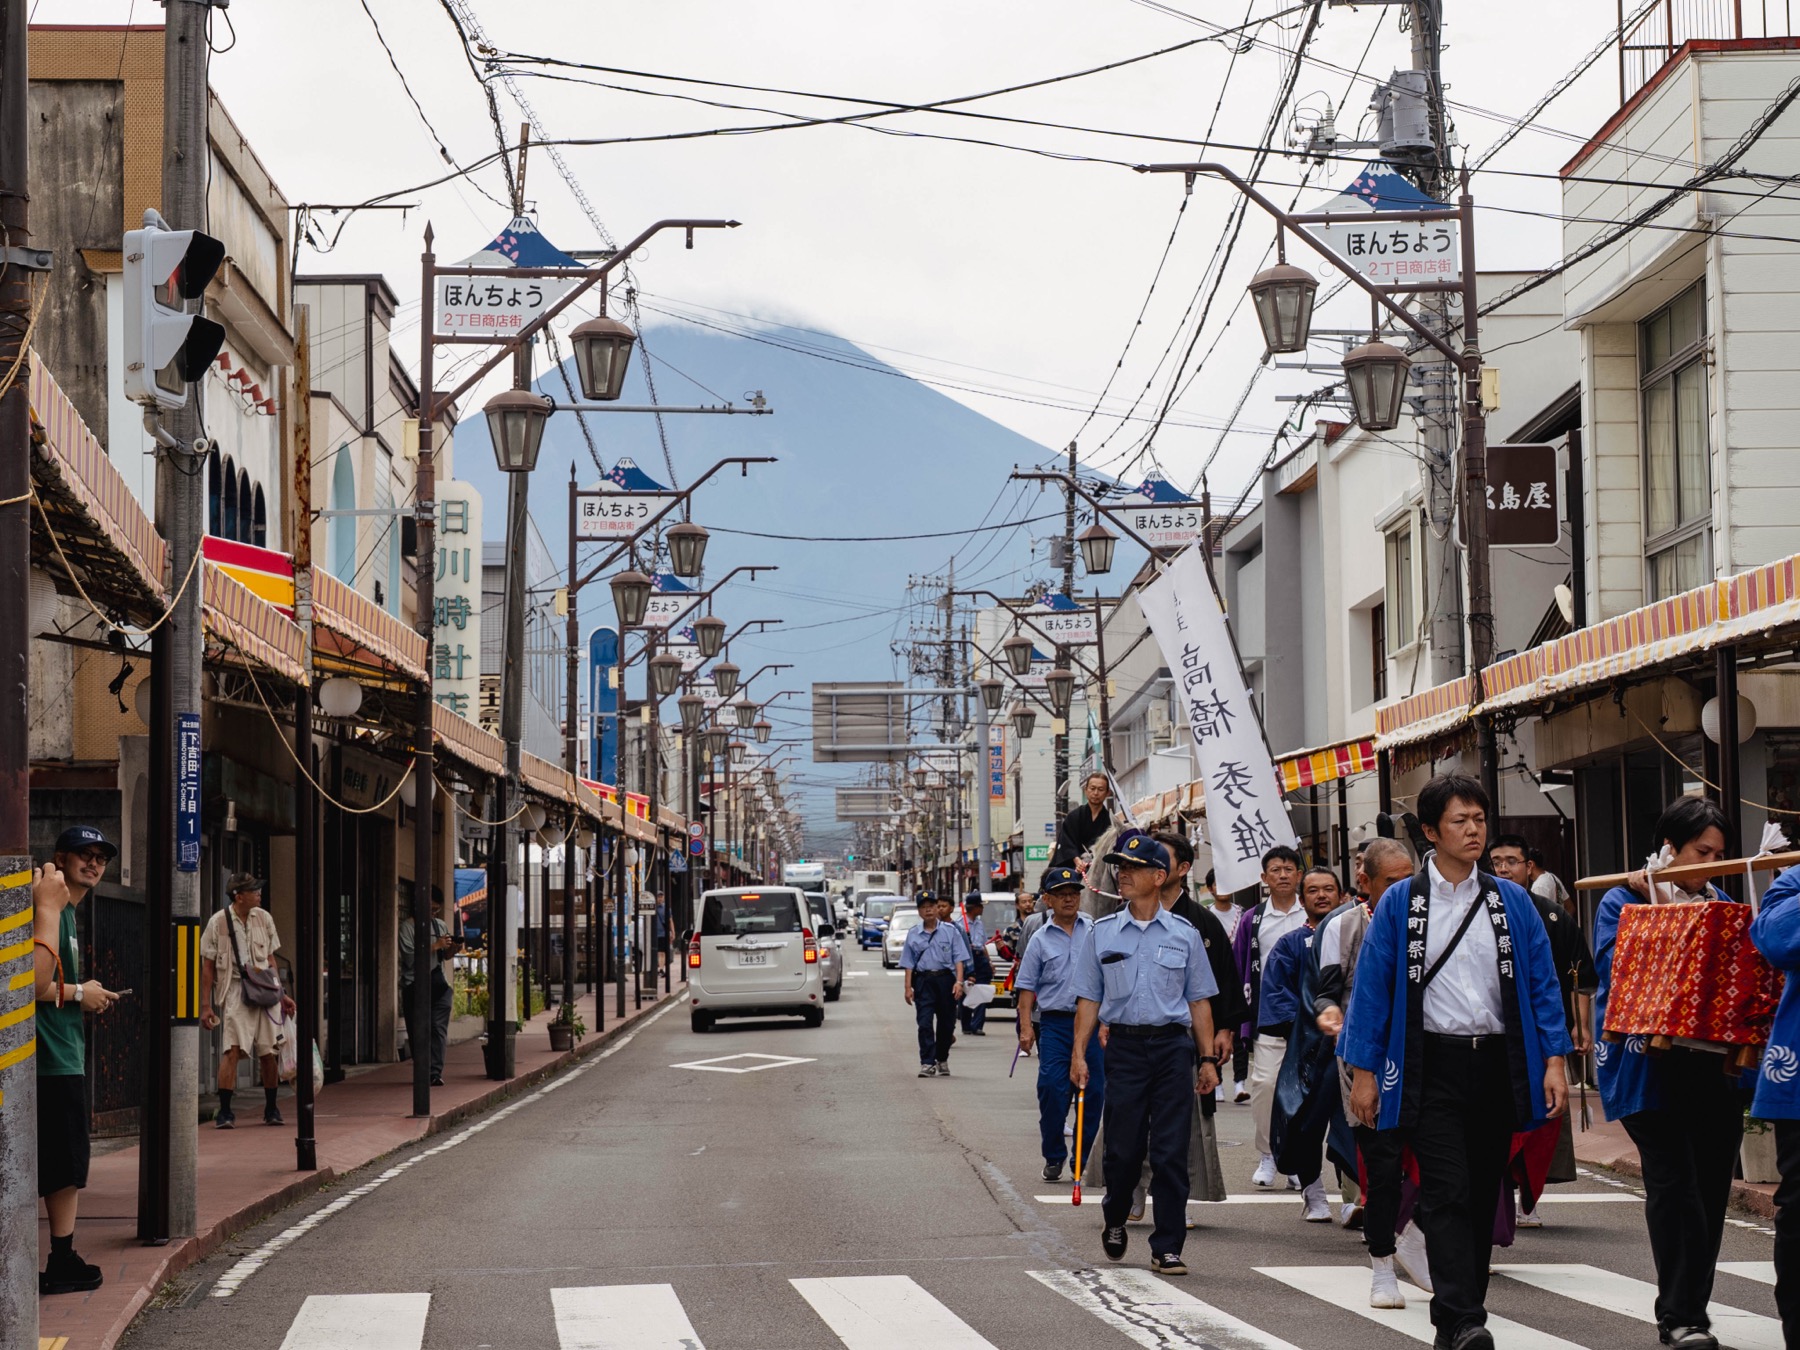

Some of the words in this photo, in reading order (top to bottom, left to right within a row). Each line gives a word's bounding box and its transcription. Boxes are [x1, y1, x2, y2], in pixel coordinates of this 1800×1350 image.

[1347, 228, 1451, 256] ほんちょう
[1368, 259, 1451, 276] 2丁目商店街
[444, 284, 543, 308] ほんちょう
[444, 313, 523, 328] 2丁目商店街
[583, 502, 648, 518] ほんちょう
[1135, 513, 1198, 529] ほんちょう
[1045, 617, 1092, 631] ほんちょう
[187, 732, 197, 813] 下吉田二丁目
[188, 818, 194, 834] 1
[1407, 894, 1427, 983] 東町祭司
[1485, 891, 1514, 978] 東町祭司
